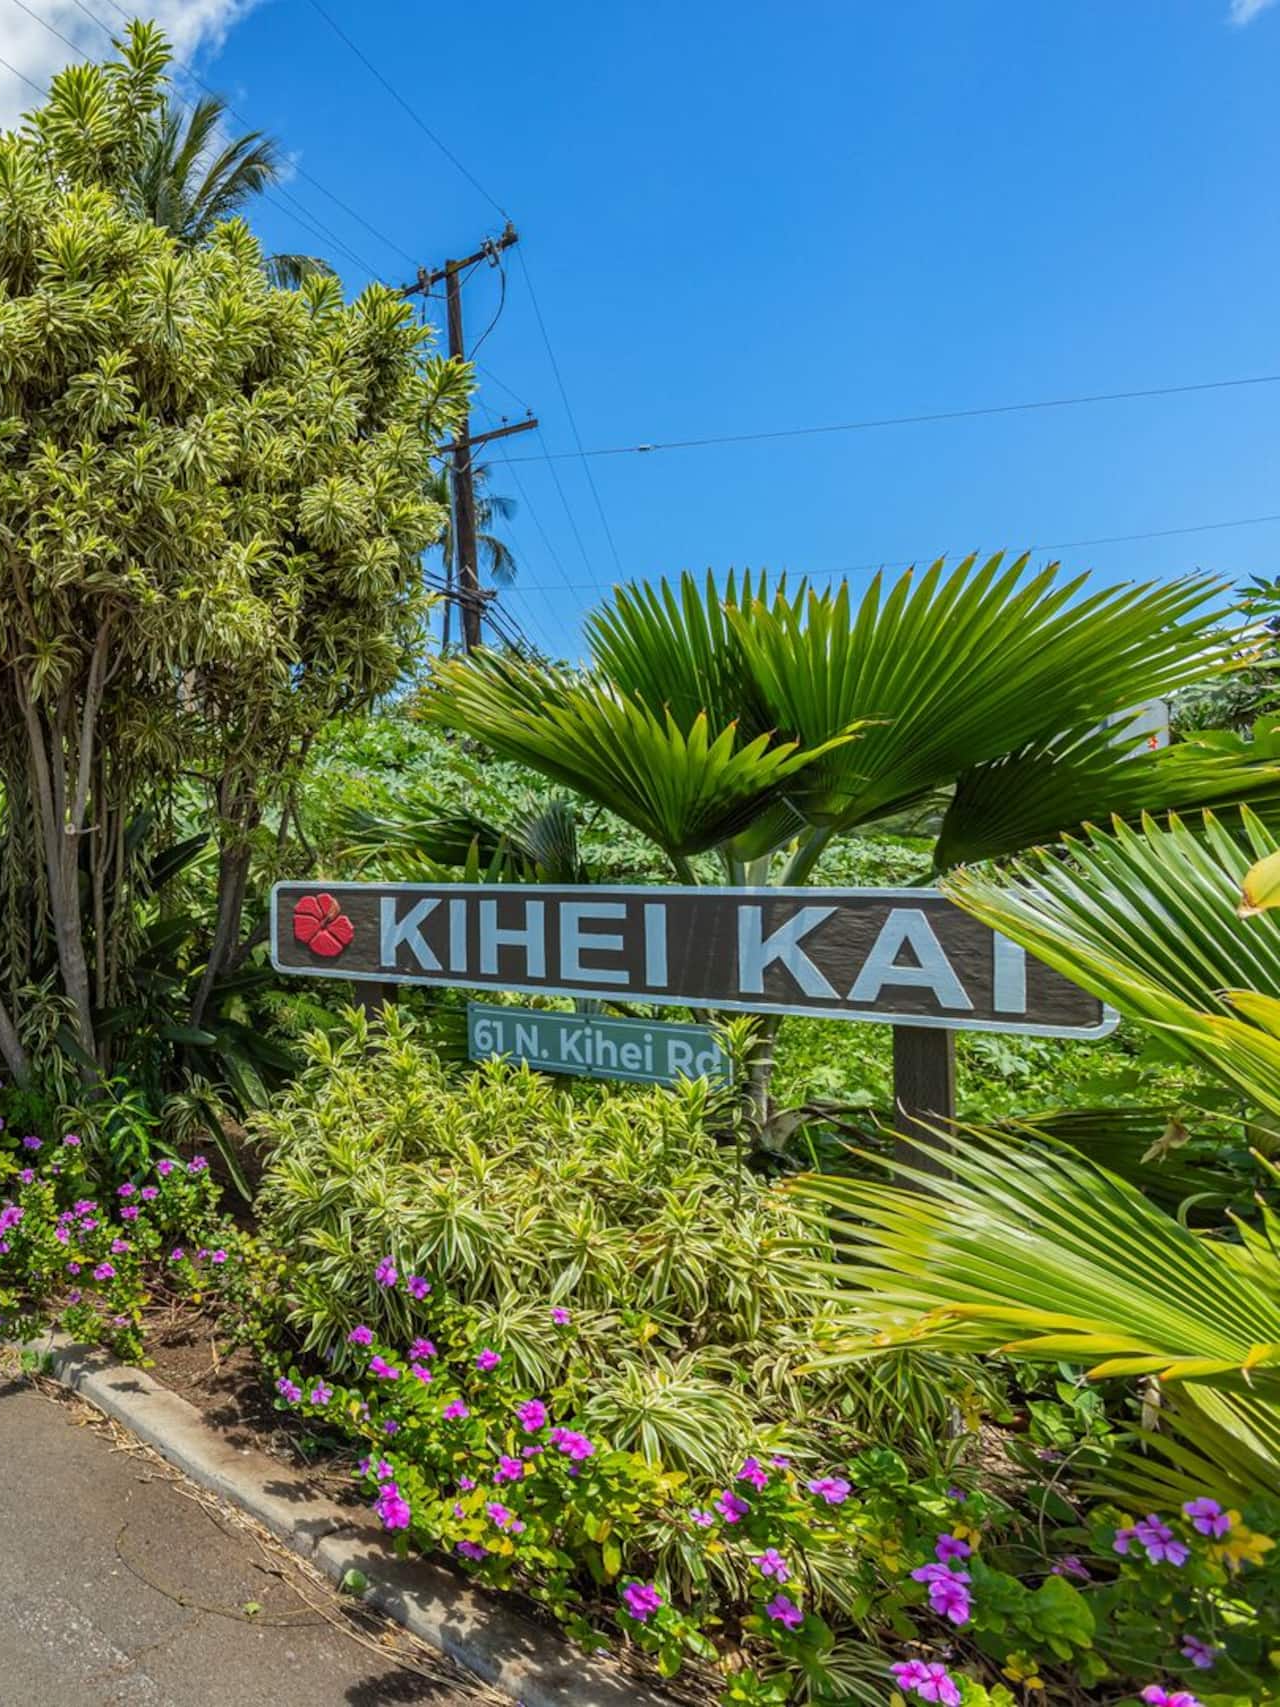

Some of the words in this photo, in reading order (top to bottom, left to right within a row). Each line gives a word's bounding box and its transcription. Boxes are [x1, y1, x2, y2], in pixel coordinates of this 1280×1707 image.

[380, 896, 669, 987] KIHEI
[738, 905, 1027, 1013] KAI
[474, 1019, 504, 1053] 61
[516, 1023, 549, 1059] N.
[560, 1026, 653, 1072] Kihei
[667, 1039, 722, 1077] Rd
